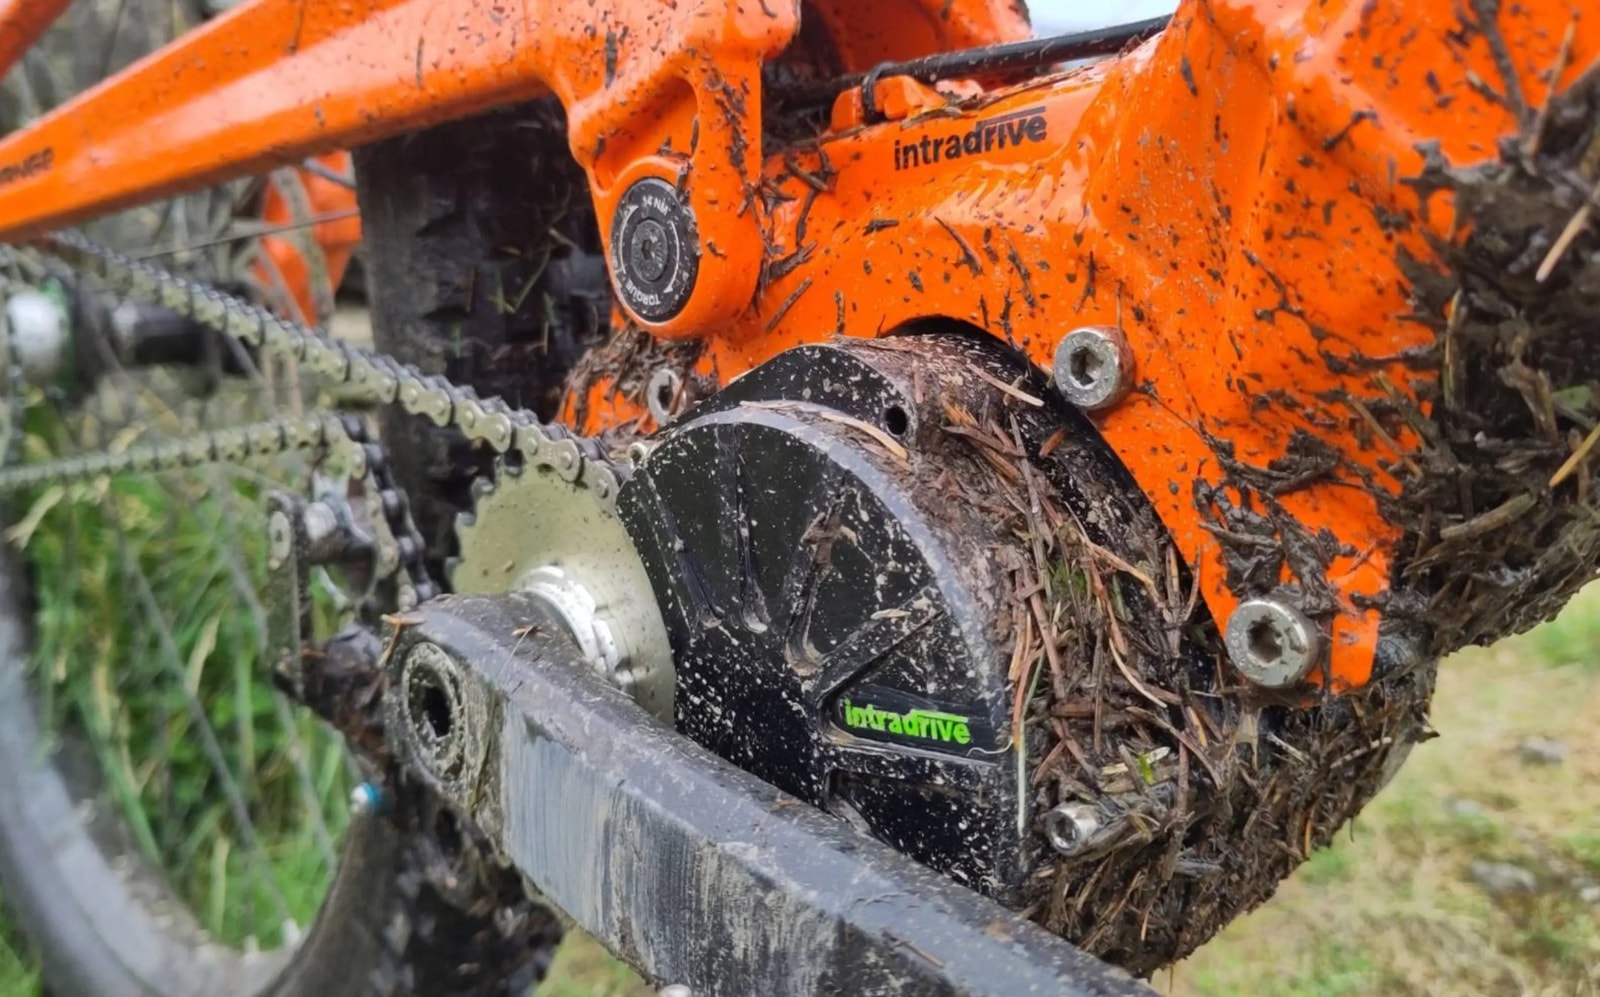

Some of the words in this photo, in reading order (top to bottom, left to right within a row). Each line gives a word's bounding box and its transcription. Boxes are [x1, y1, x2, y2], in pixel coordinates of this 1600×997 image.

[894, 106, 1047, 171] intradrive
[625, 279, 661, 306] TORQUE
[844, 698, 971, 745] intradrive
